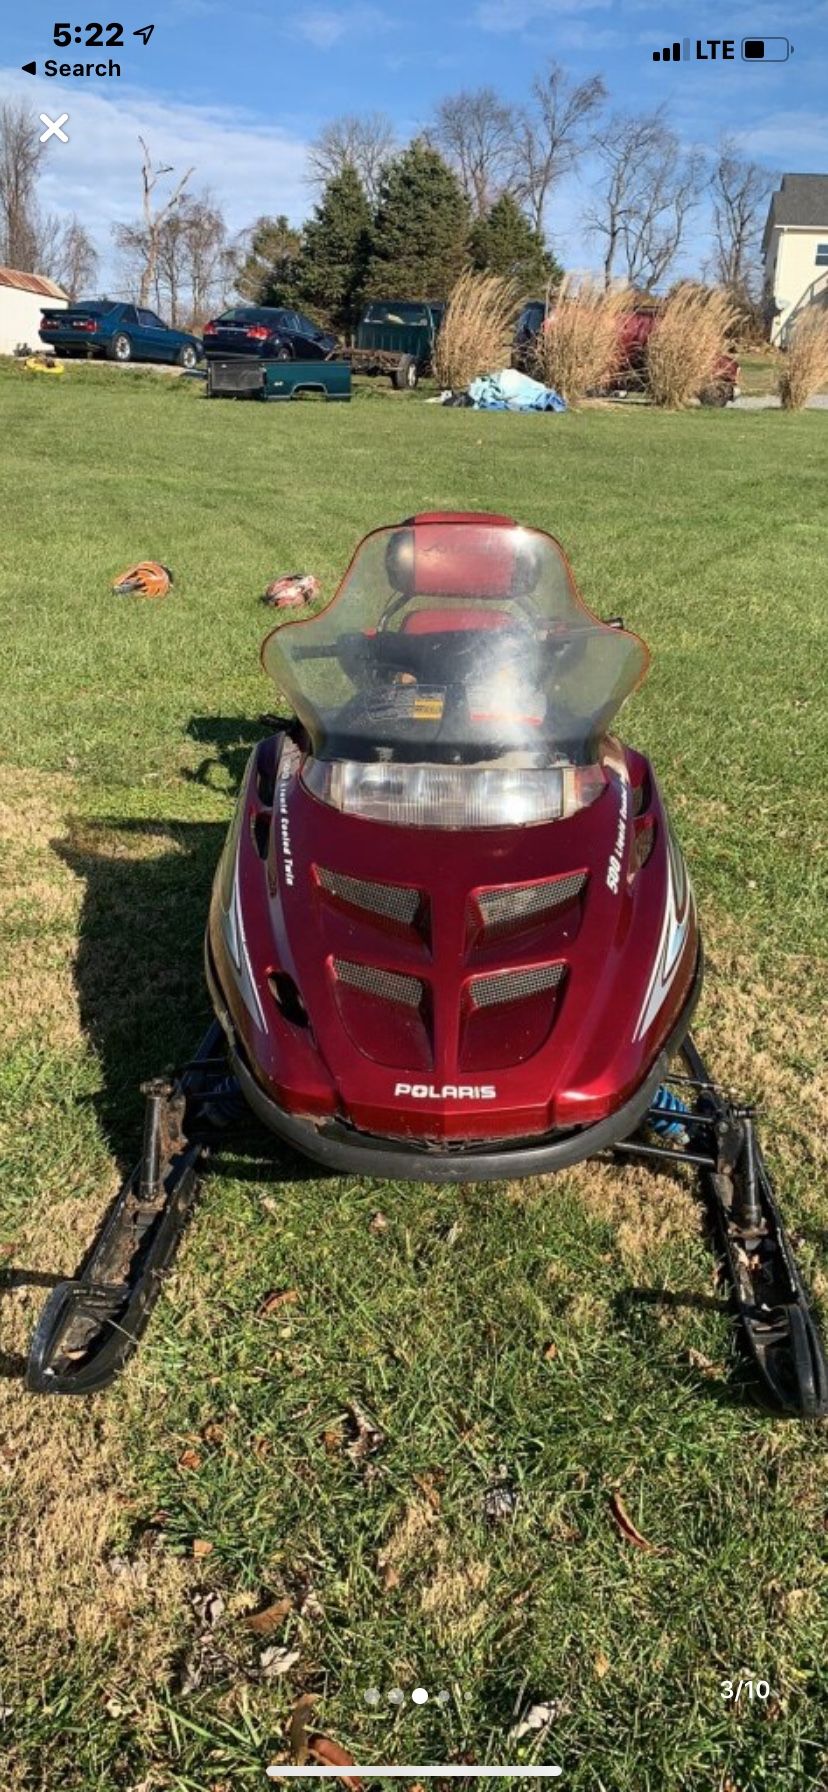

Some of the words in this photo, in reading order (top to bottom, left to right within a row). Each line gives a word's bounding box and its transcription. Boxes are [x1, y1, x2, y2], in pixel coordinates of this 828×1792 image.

[281, 818, 292, 855] Cooled
[284, 859, 294, 886] Twin
[606, 855, 621, 895] 500
[394, 1083, 496, 1099] POLARIS
